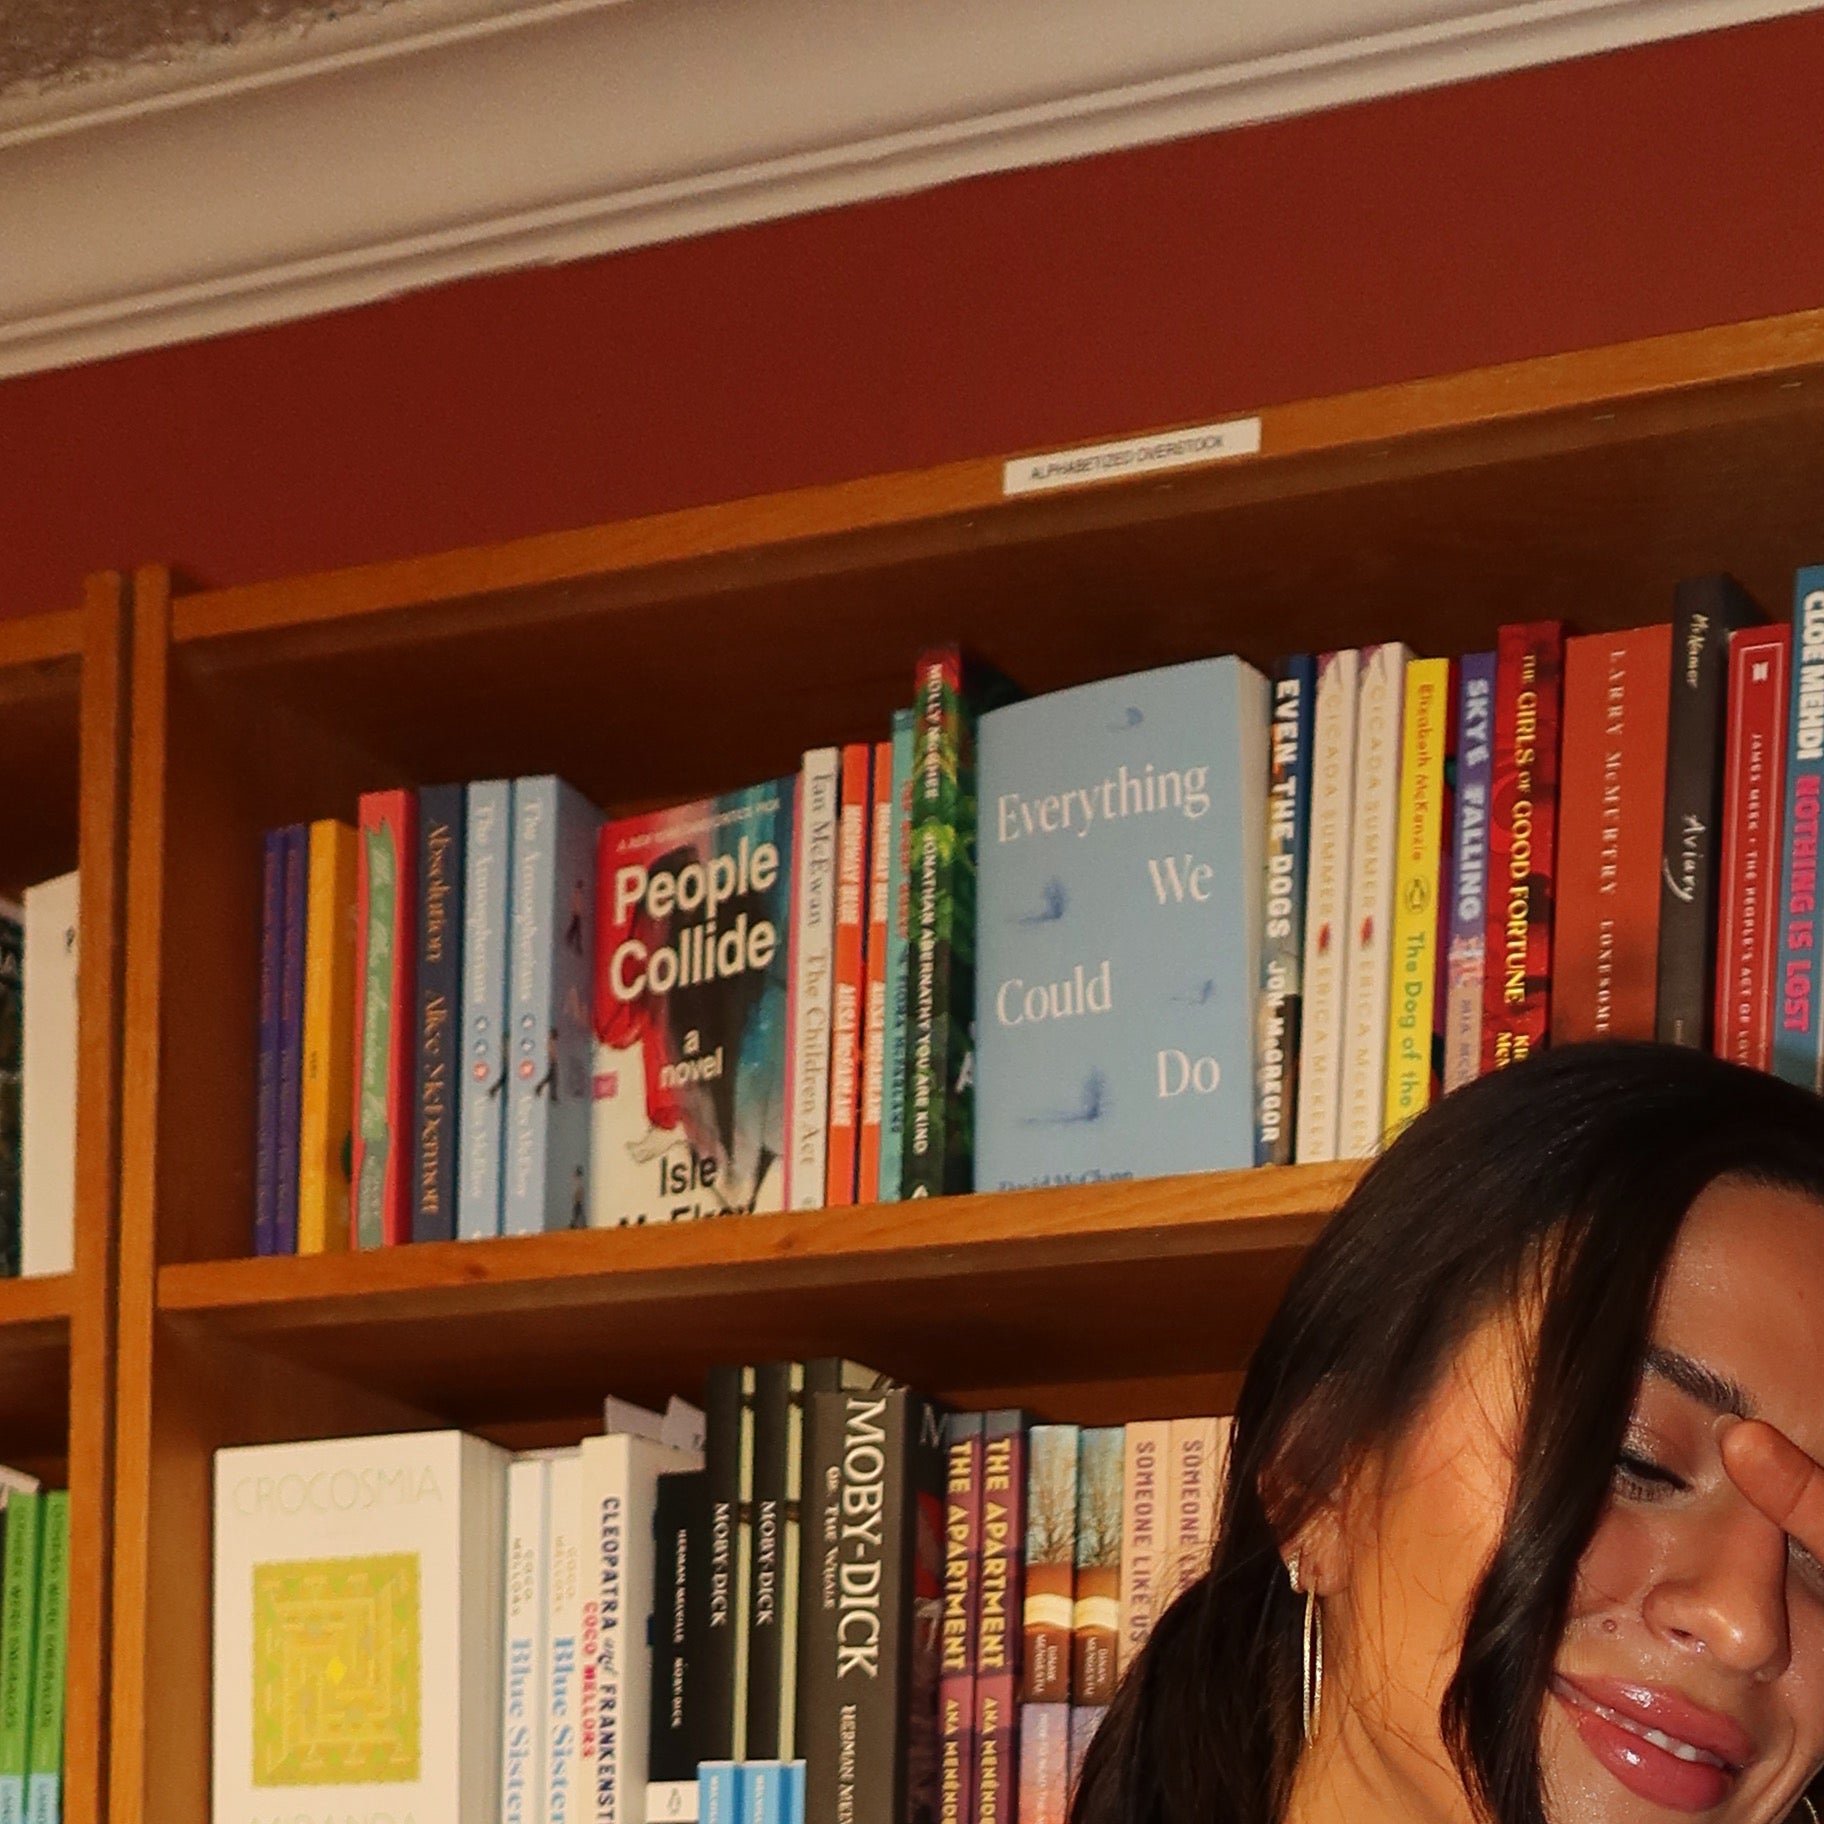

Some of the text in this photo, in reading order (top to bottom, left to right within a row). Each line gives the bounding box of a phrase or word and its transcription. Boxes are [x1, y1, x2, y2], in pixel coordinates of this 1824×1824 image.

[1029, 434, 1224, 481] ALPHABETIZED OVERSTOCK
[998, 760, 1211, 844] Everything
[1504, 654, 1538, 1004] THE GIRLS OF GOOD FORTUNE
[613, 836, 781, 927] People
[1147, 853, 1214, 906] We
[1790, 775, 1820, 915] NOTHING
[1261, 679, 1300, 1143] EVEN THE DOGS JON McGREGOR
[1788, 921, 1814, 950] IS
[609, 920, 777, 1001] Collide
[996, 961, 1113, 1026] Could
[1784, 960, 1812, 1032] LOST
[659, 1053, 723, 1090] novel
[1155, 1047, 1221, 1099] Do
[659, 1153, 719, 1196] Isle
[231, 1465, 443, 1519] CROCOSMIA
[710, 1502, 730, 1628] MOBY-DICK
[836, 1397, 886, 1680] MOBY-DICK
[942, 1441, 972, 1671] THE APARTMENT
[1130, 1441, 1155, 1644] SOMEONE LIKE US
[552, 1638, 575, 1717] Blue
[581, 1601, 599, 1758] COCO MELLORS
